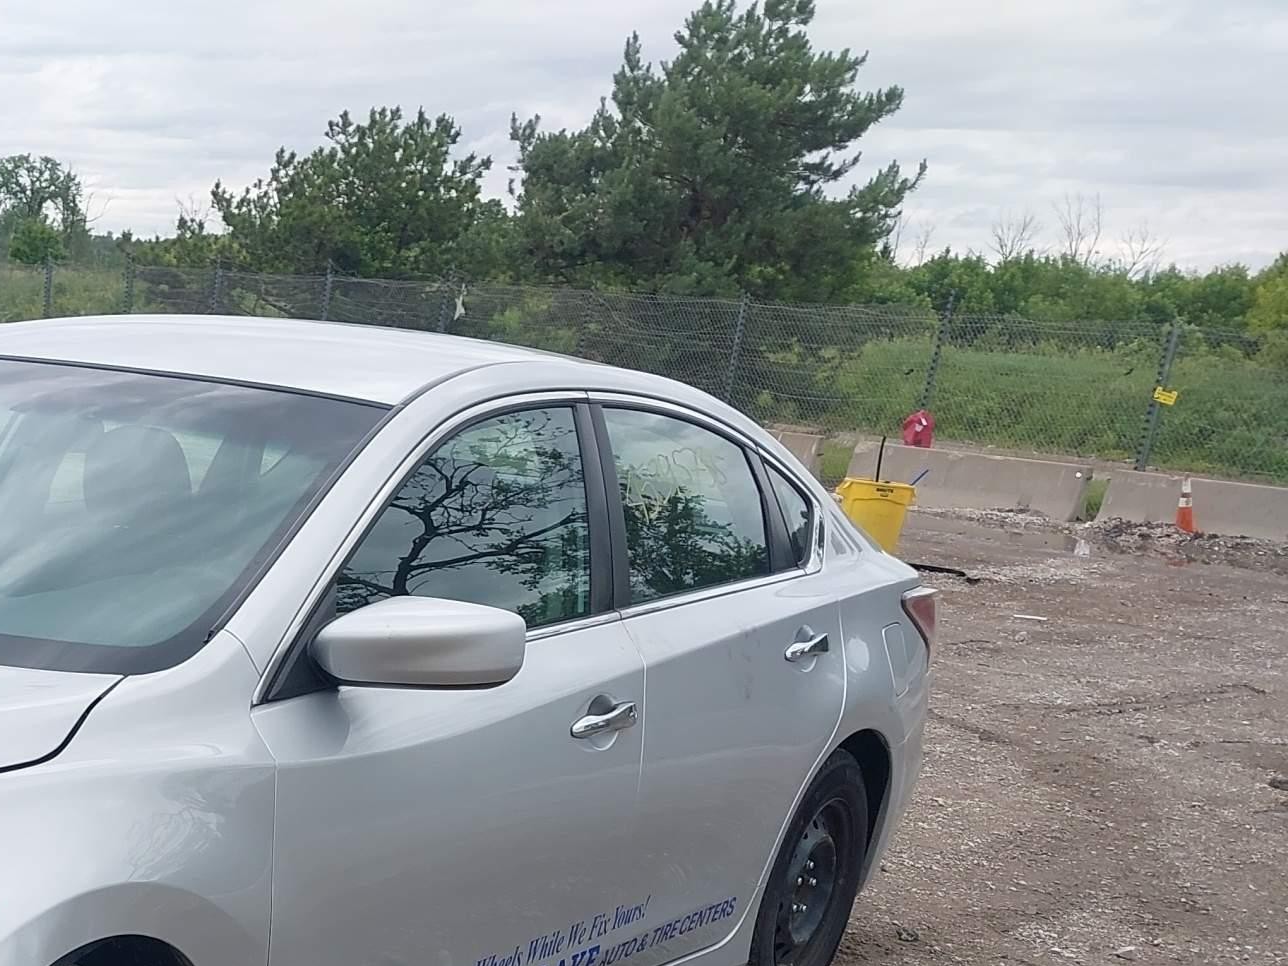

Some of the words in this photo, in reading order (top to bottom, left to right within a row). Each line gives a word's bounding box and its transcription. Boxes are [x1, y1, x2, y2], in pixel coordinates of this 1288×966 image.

[526, 929, 566, 966] While
[567, 920, 587, 948] We
[588, 912, 612, 941] Fix
[611, 894, 652, 931] Yours!
[637, 933, 650, 953] &
